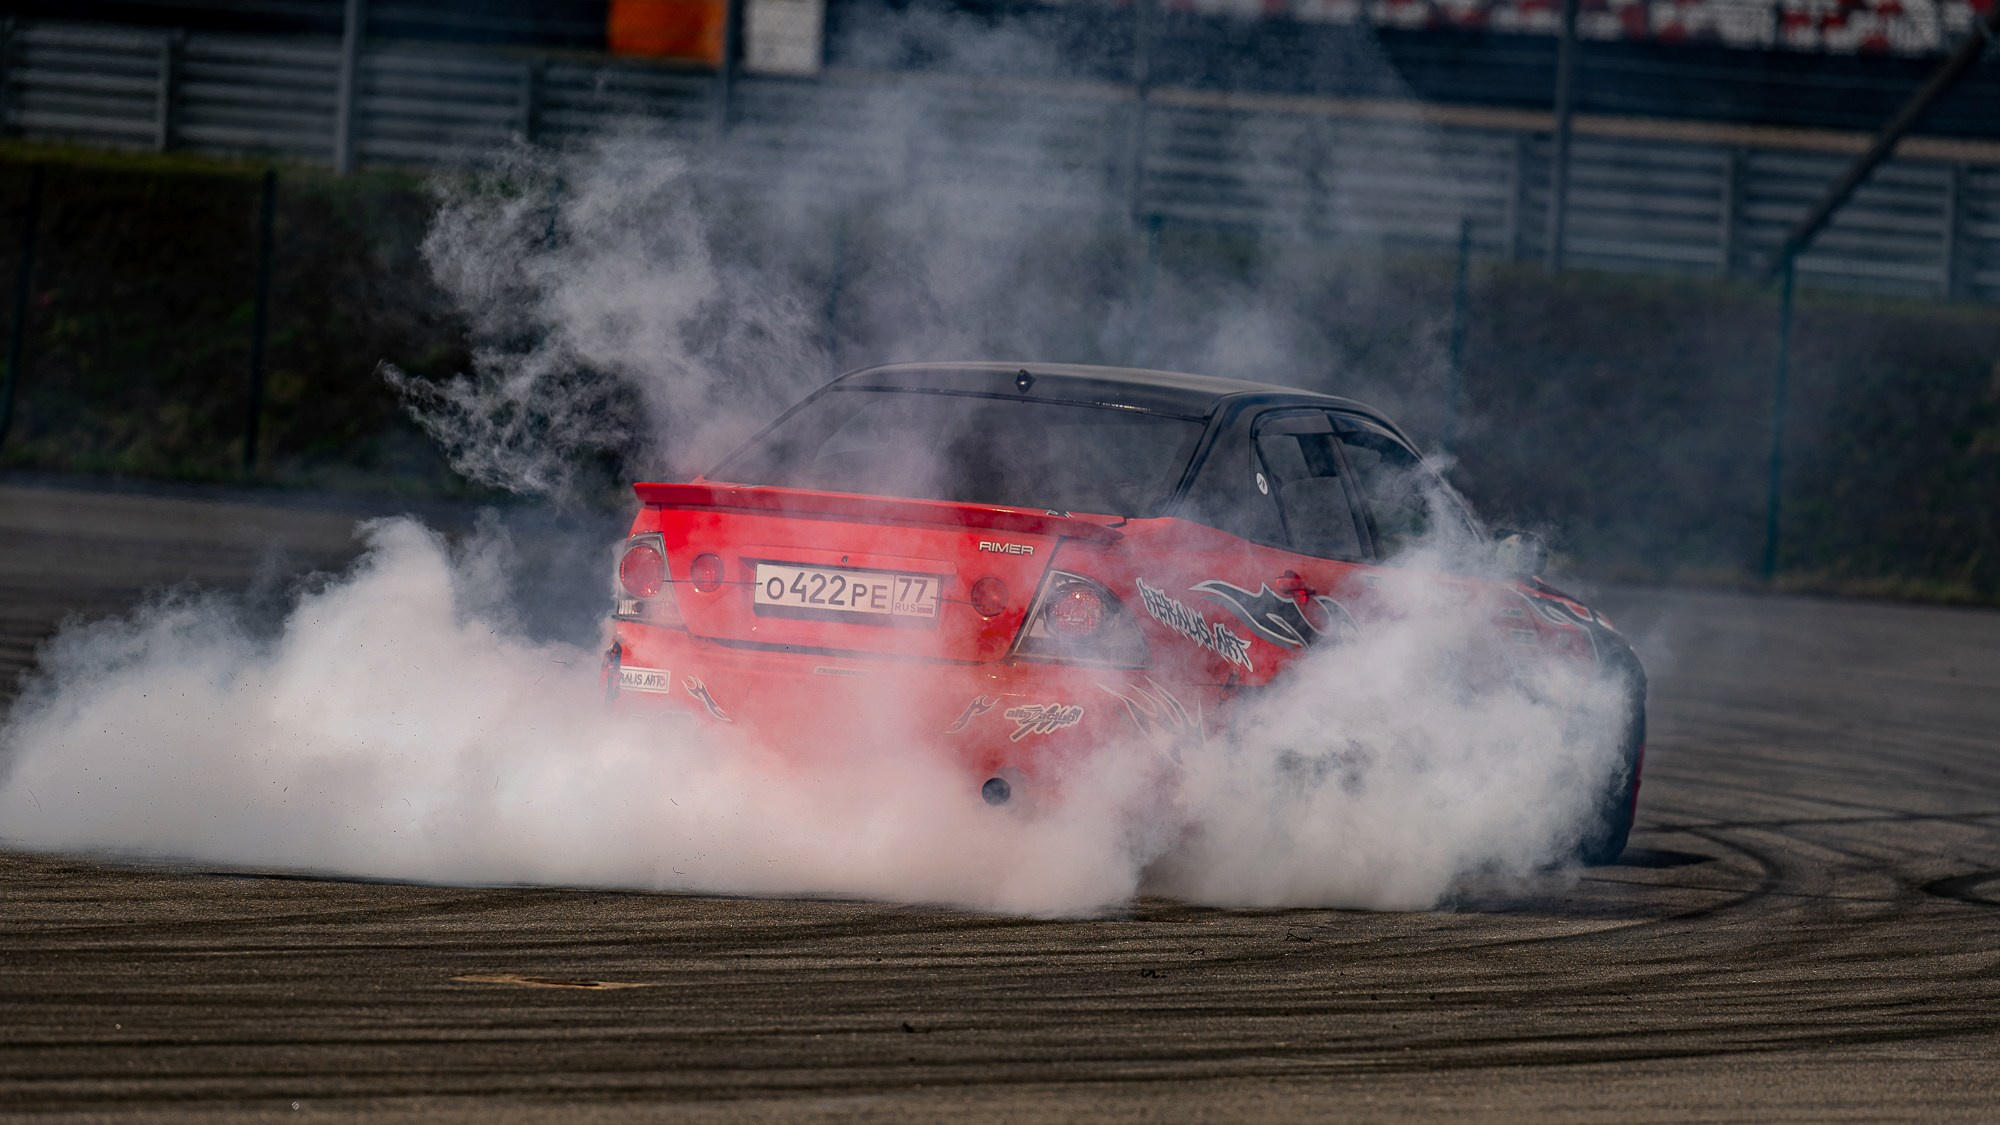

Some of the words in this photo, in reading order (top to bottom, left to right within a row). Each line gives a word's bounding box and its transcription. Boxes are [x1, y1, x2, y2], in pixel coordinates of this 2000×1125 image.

[979, 541, 1034, 555] RIMER
[898, 577, 928, 603] 77
[894, 602, 917, 612] RUS
